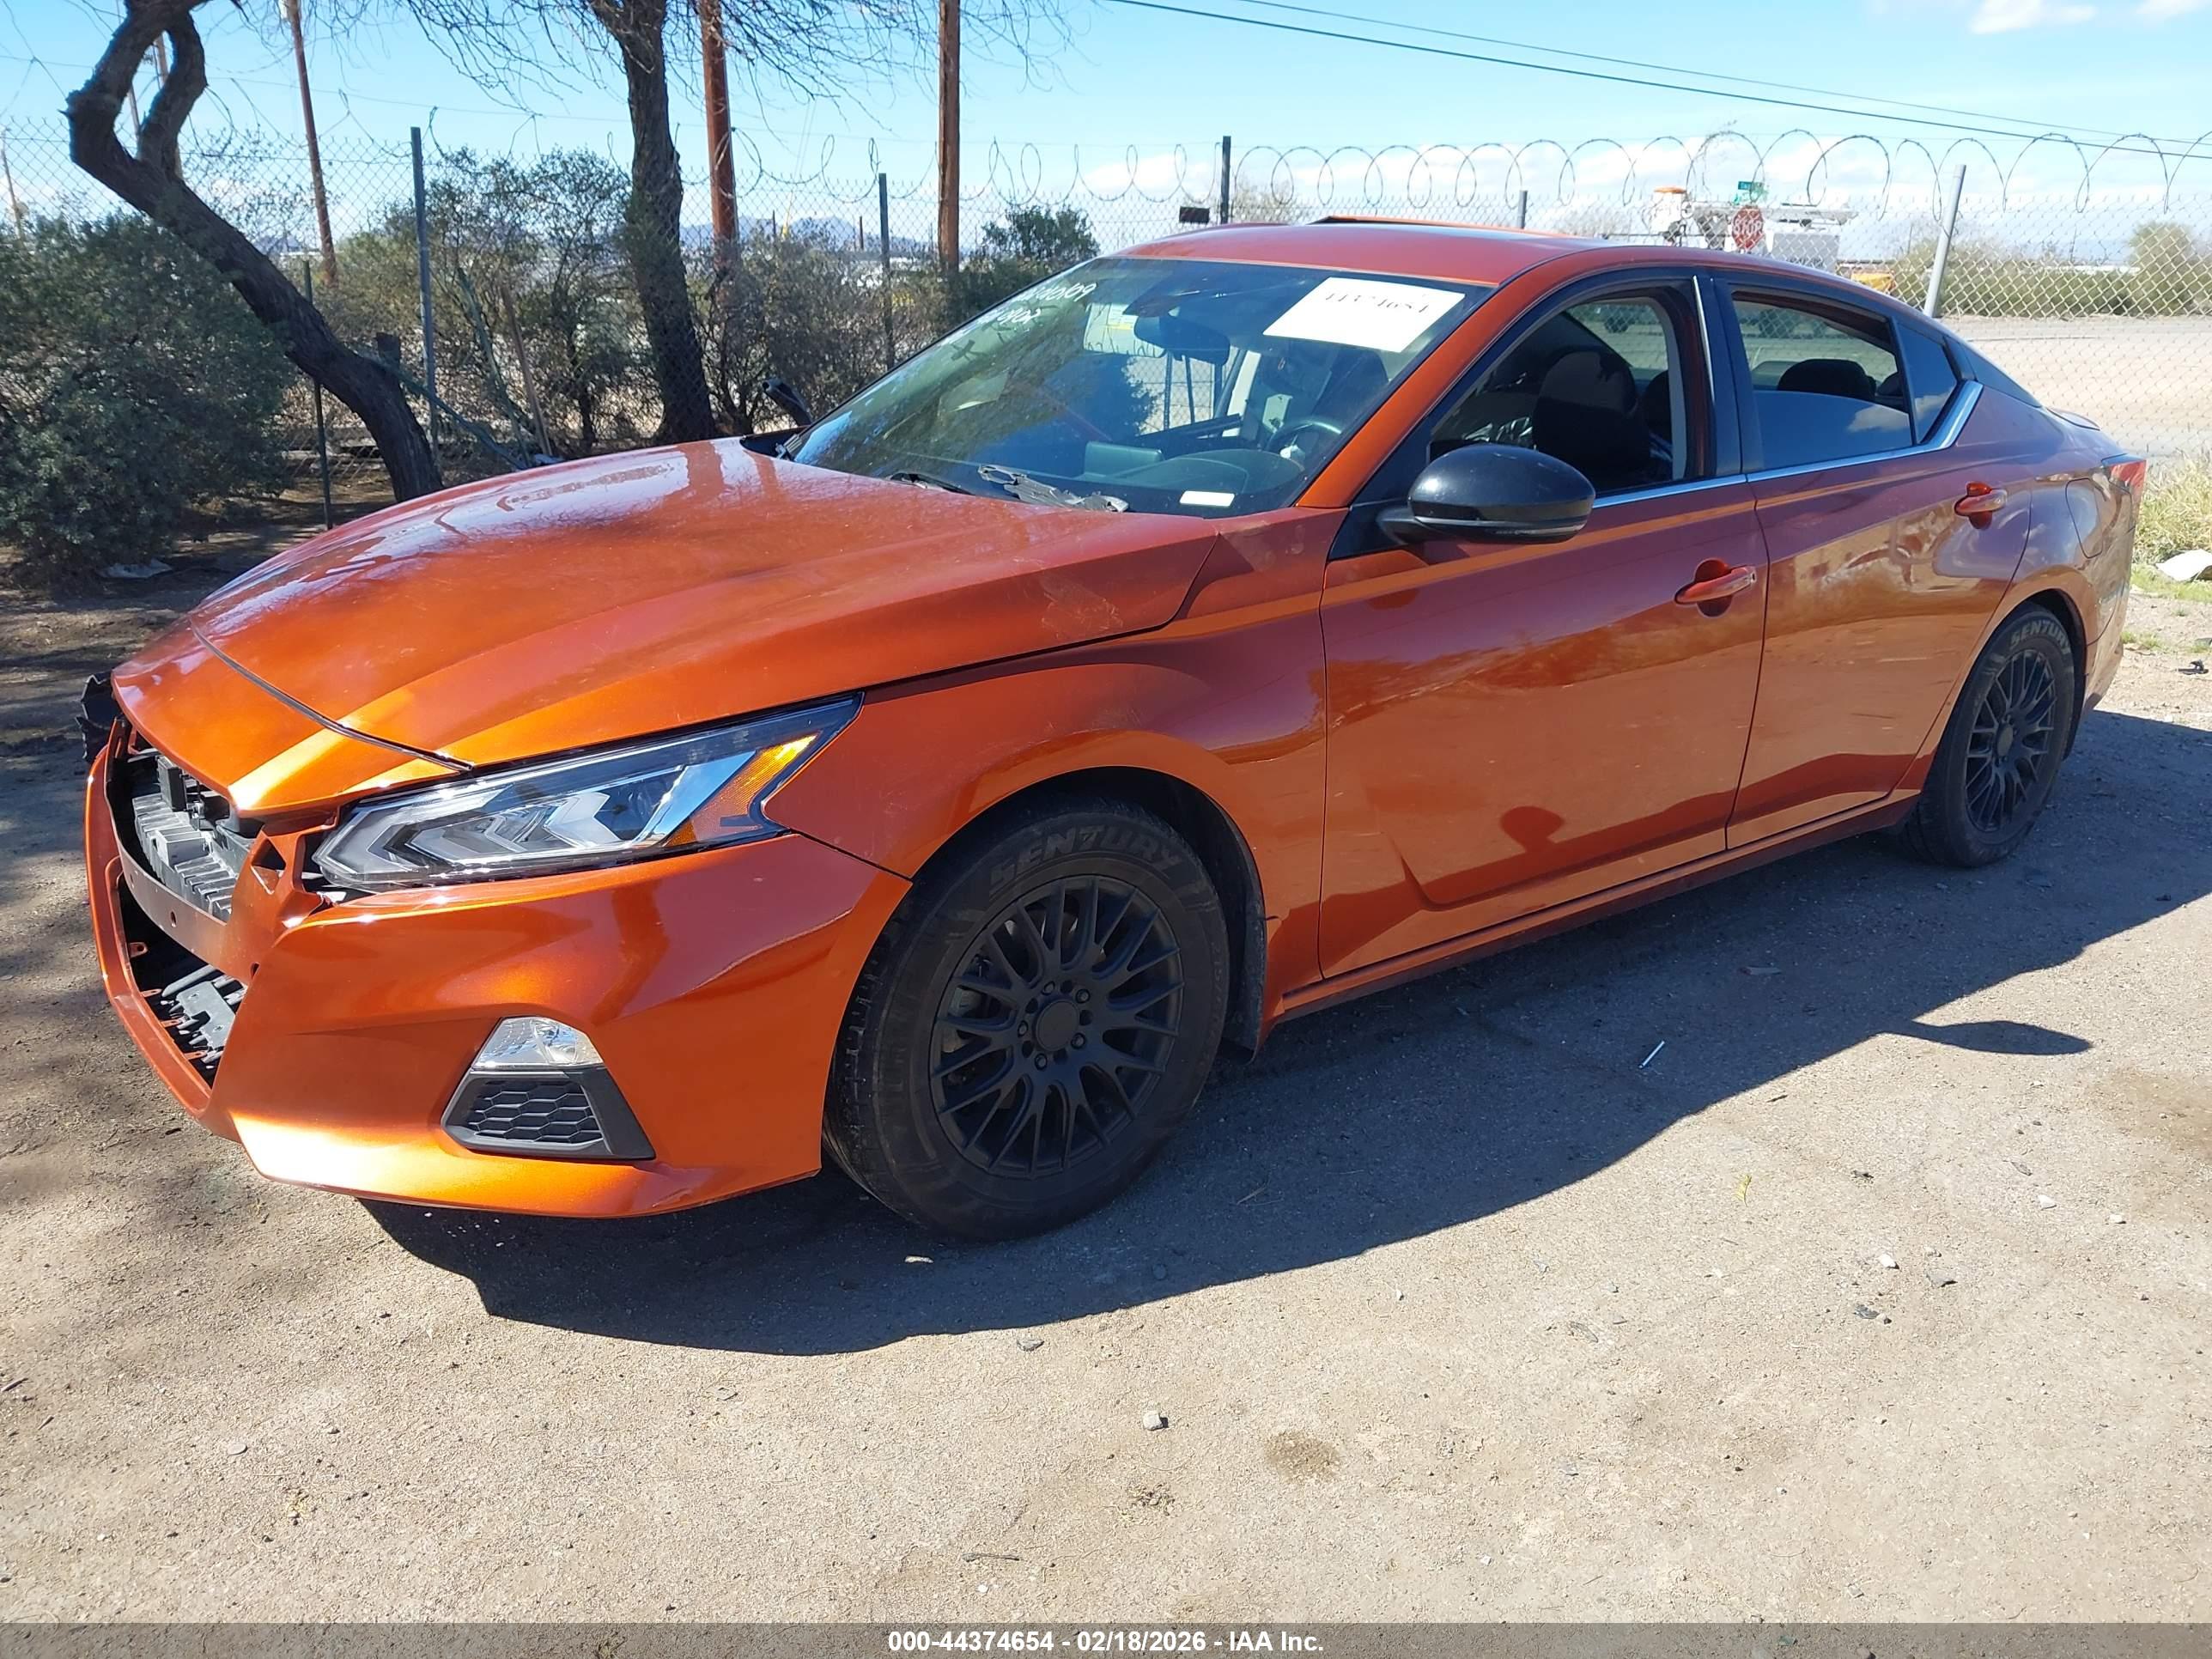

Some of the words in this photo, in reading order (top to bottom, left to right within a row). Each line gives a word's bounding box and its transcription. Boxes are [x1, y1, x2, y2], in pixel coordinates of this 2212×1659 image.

[1735, 221, 1762, 236] STOP
[2009, 619, 2071, 653] SENTURY
[990, 824, 1182, 884] SENTURY
